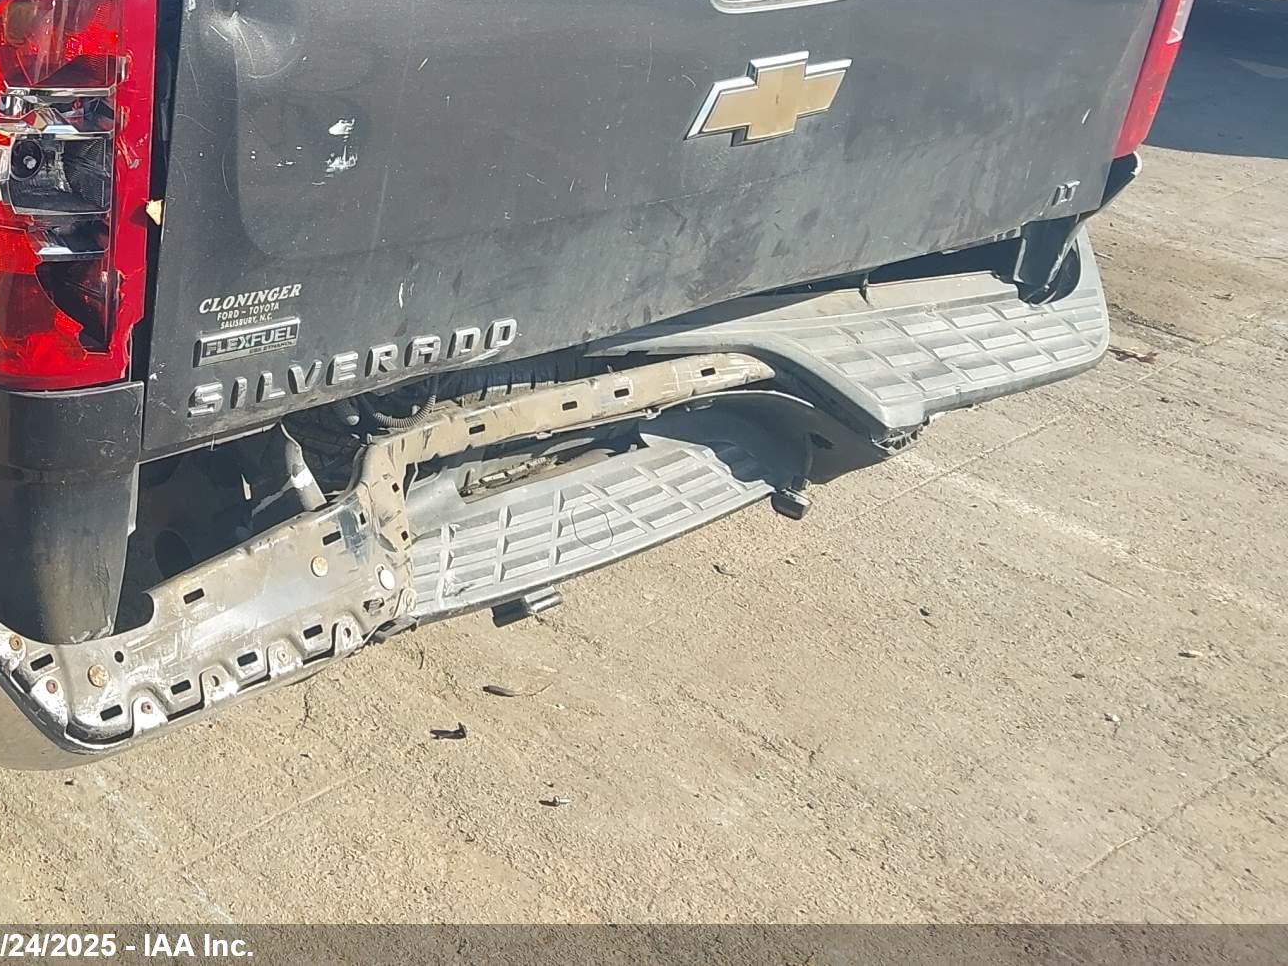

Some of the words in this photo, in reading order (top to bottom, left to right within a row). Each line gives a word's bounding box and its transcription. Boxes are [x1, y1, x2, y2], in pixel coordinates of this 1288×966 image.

[199, 283, 303, 314] CLONINGER
[217, 309, 240, 321] FORD
[249, 301, 280, 316] TOYOTA
[188, 318, 518, 418] SILVERADO
